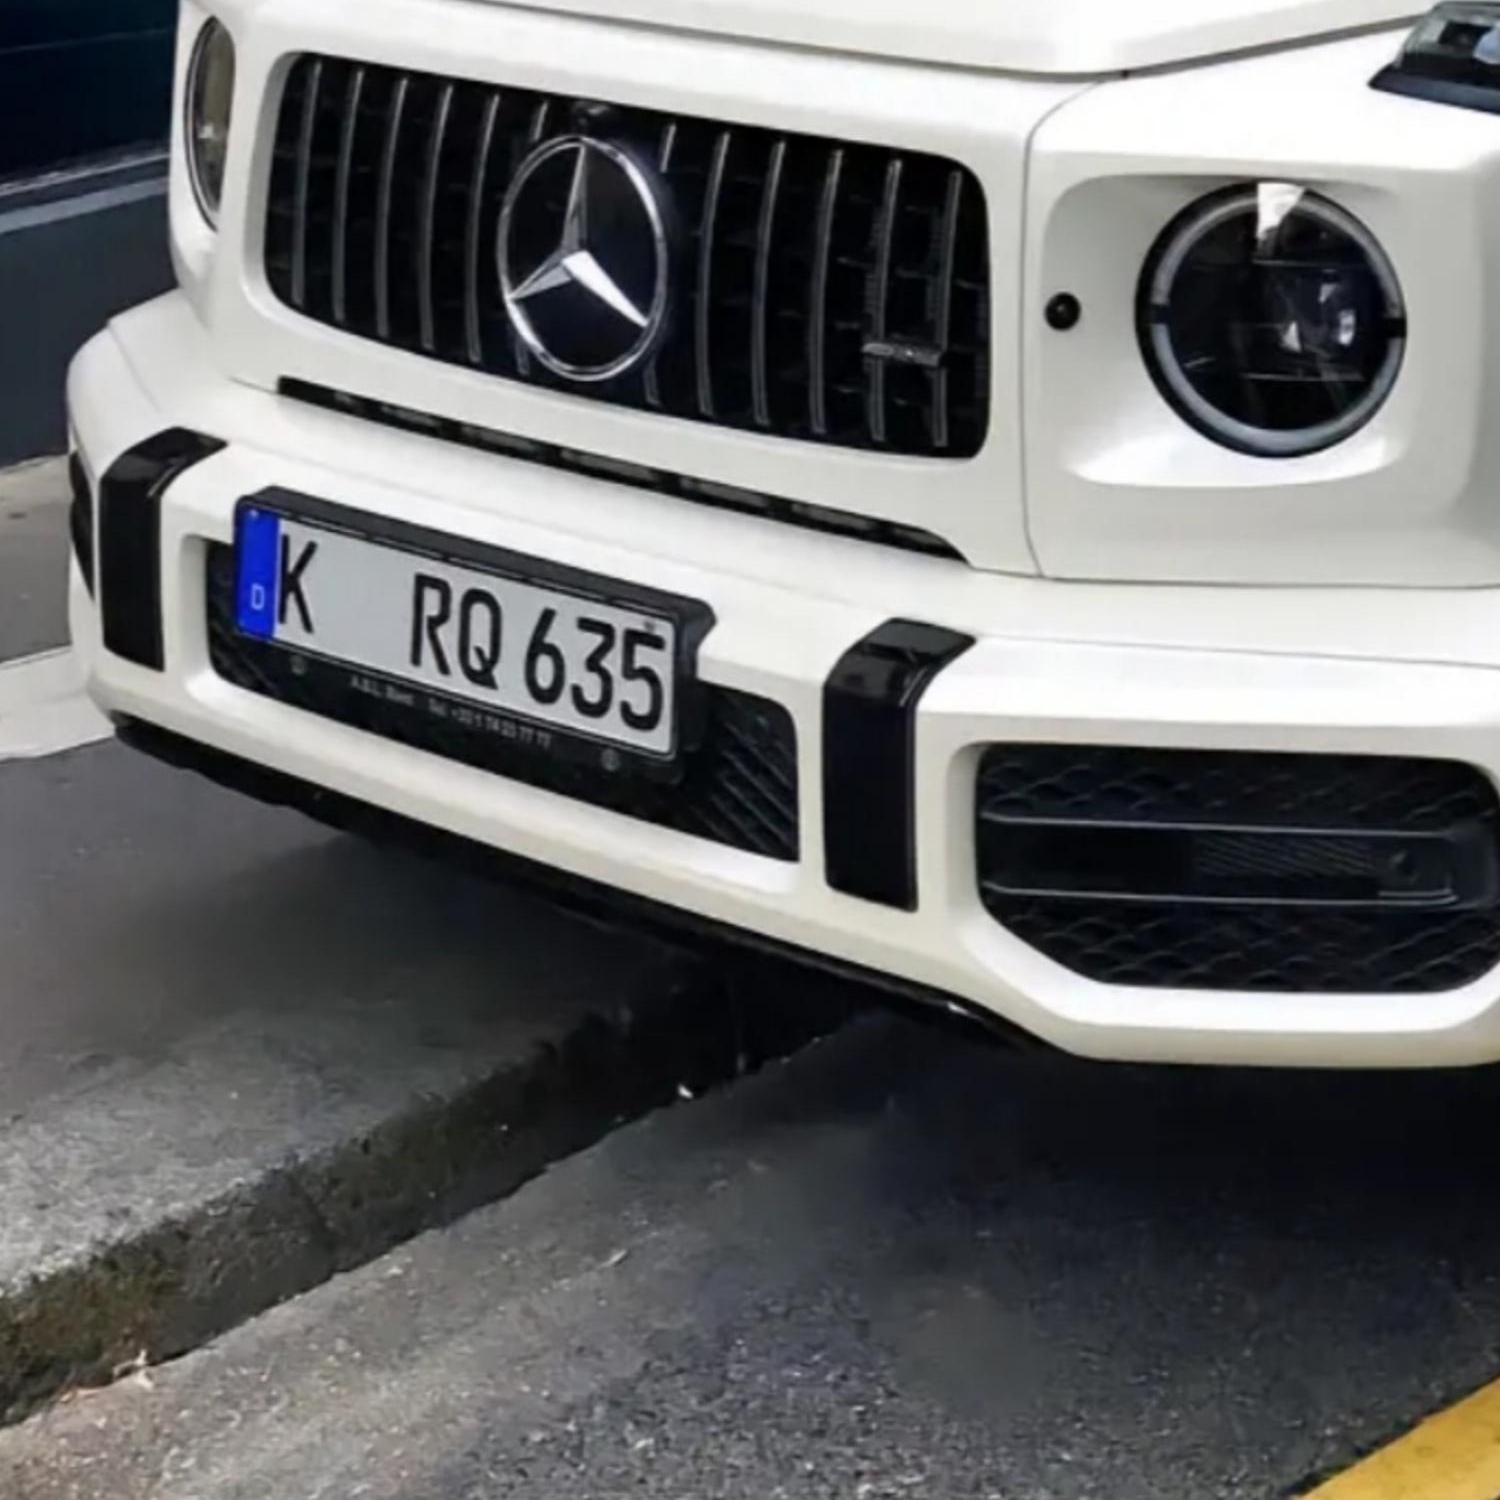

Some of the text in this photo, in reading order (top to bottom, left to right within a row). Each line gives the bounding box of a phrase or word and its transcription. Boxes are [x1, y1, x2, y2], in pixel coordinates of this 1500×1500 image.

[278, 533, 666, 731] K RQ 635
